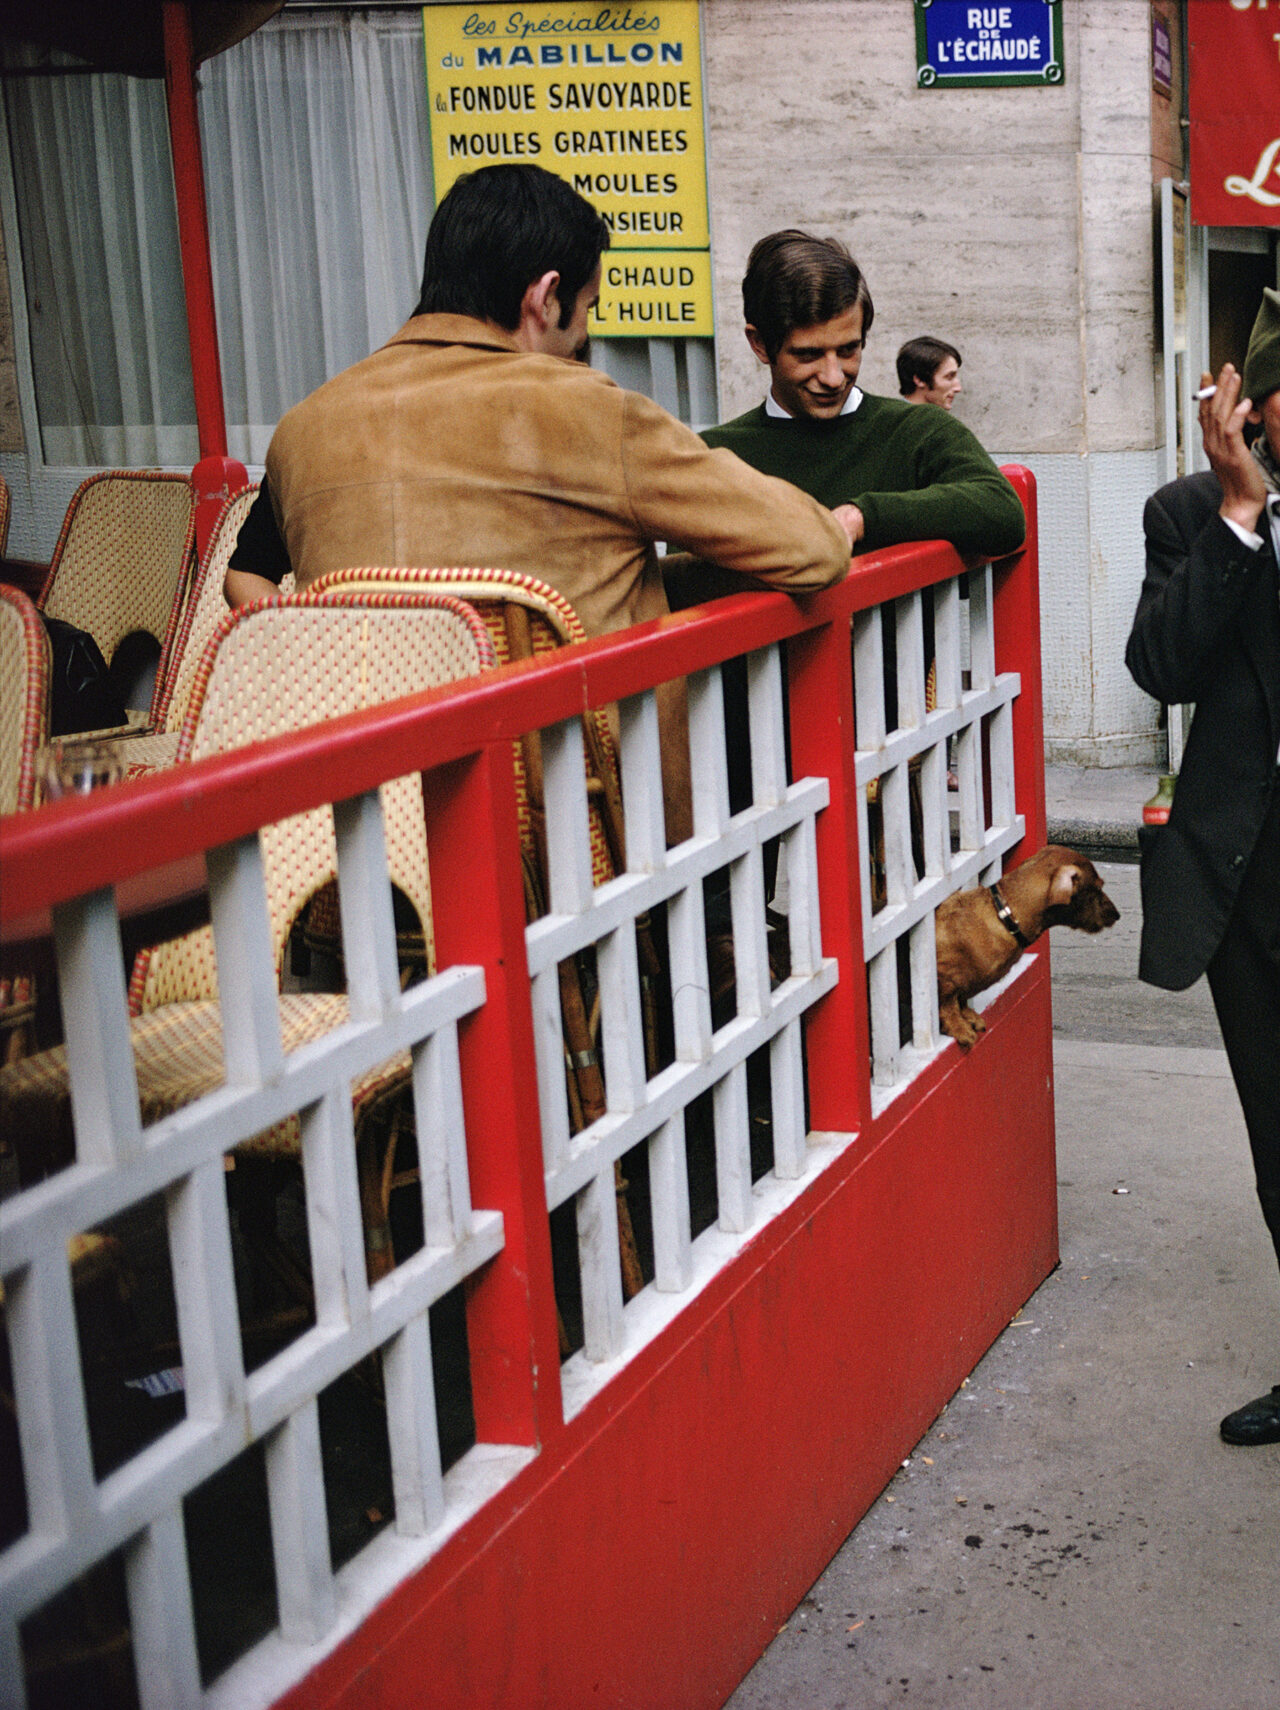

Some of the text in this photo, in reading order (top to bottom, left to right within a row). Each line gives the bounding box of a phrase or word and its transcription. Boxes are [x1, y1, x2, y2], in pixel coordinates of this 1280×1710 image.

[505, 9, 660, 39] Spécialités
[967, 8, 1013, 29] RUE
[978, 29, 1001, 40] DE
[441, 42, 683, 68] du MABILLON
[938, 35, 1041, 62] L'ÉCHAUDÉ
[435, 81, 692, 112] la FONDUE SAVOYARDE
[450, 130, 687, 156] MOULES GRATINEES
[574, 173, 677, 193] MOULES
[601, 212, 683, 231] NSIEUR
[608, 267, 694, 287] CHAUD
